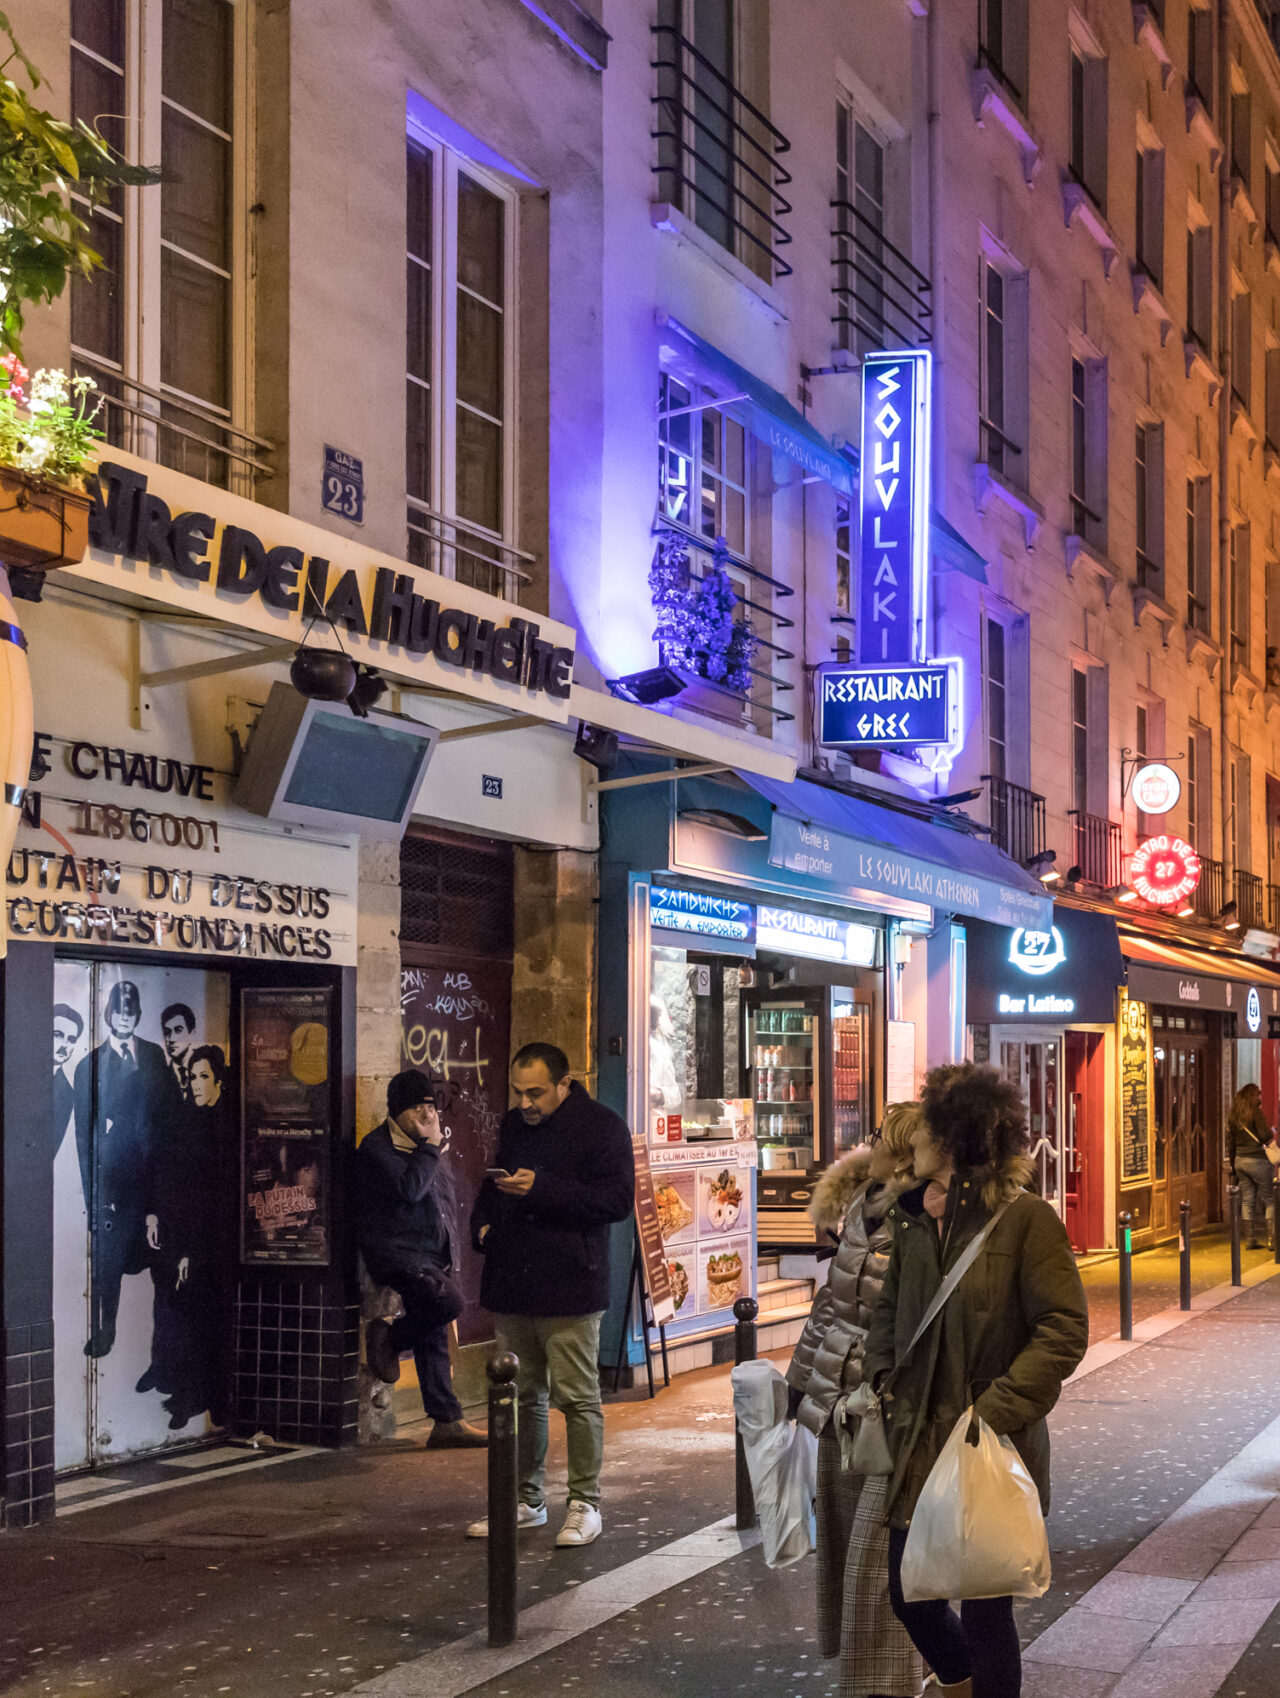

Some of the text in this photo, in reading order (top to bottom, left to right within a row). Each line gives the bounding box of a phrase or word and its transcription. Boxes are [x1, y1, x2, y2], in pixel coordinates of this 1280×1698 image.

[335, 451, 360, 471] GAZ
[327, 477, 358, 516] 23
[873, 366, 903, 660] SOUVLAKI
[215, 525, 305, 612] DE
[301, 556, 368, 636] LA
[369, 567, 574, 699] HUCHETTE
[824, 675, 944, 703] RESTAURANT
[856, 712, 911, 740] GREC
[70, 741, 215, 801] CHAUVE
[485, 779, 500, 795] 23
[798, 827, 822, 849] Vente
[794, 852, 833, 875] emporter
[1131, 835, 1200, 875] BISTRO DE LA
[859, 854, 873, 879] LE
[876, 858, 933, 896] SOUVLAKI
[935, 878, 980, 909] ATHENIEN
[1155, 861, 1176, 878] 27
[7, 848, 331, 920] UTAIN DU DESSUS
[1133, 875, 1196, 905] HUCHETTE
[657, 887, 742, 920] SANDWICHS
[9, 896, 333, 960] CORRESPONDANCES
[760, 907, 839, 940] RESTAURANT
[1024, 936, 1051, 956] 27
[998, 993, 1075, 1013] Bar Latino
[1178, 980, 1200, 1001] Cocktails
[662, 1149, 705, 1162] CLIMATISEE
[706, 1149, 717, 1159] AU
[256, 1197, 317, 1219] DU DESSUS
[265, 1185, 306, 1204] PUTAIN
